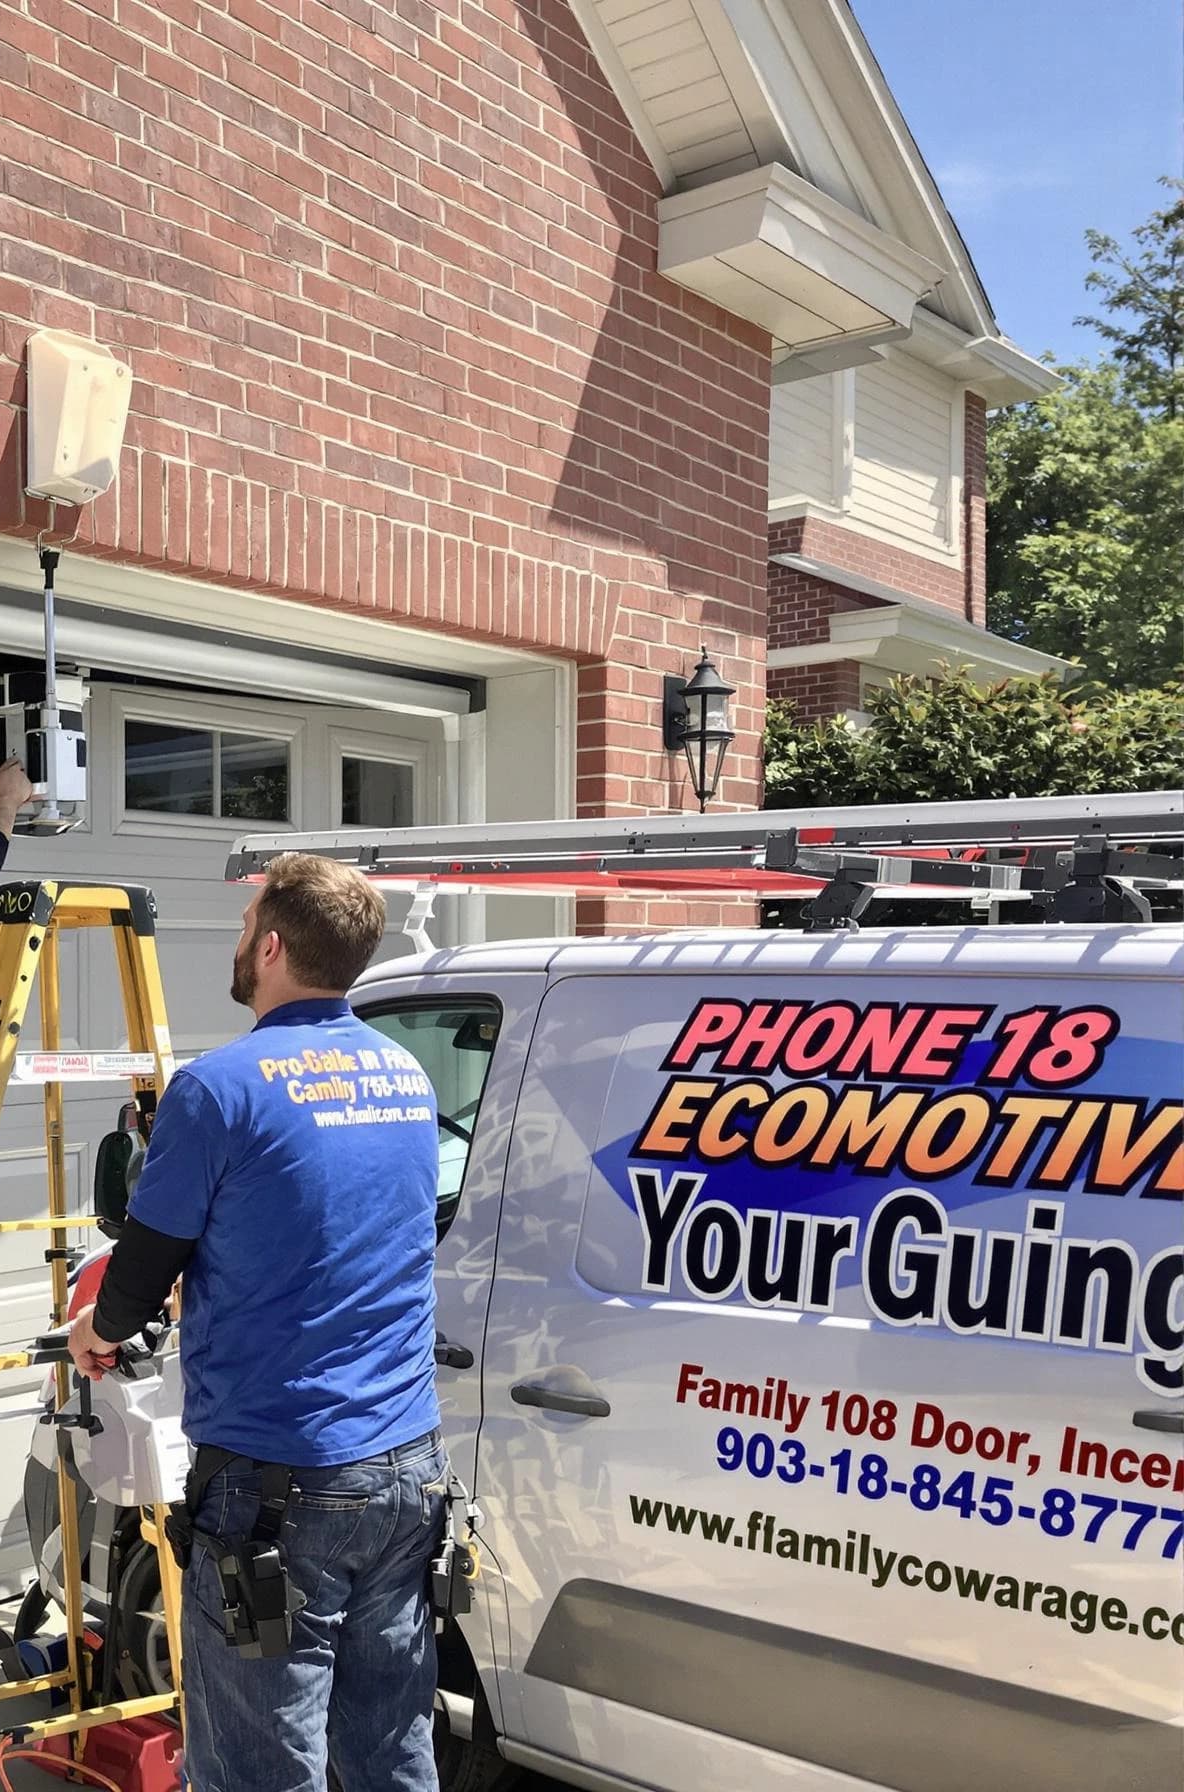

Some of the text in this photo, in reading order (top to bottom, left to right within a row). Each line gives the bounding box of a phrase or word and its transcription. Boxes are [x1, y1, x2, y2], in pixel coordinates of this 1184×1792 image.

[659, 997, 1120, 1089] PHONE 18
[676, 1363, 809, 1433] Family
[820, 1390, 897, 1441] 108
[911, 1402, 1042, 1476] Door,
